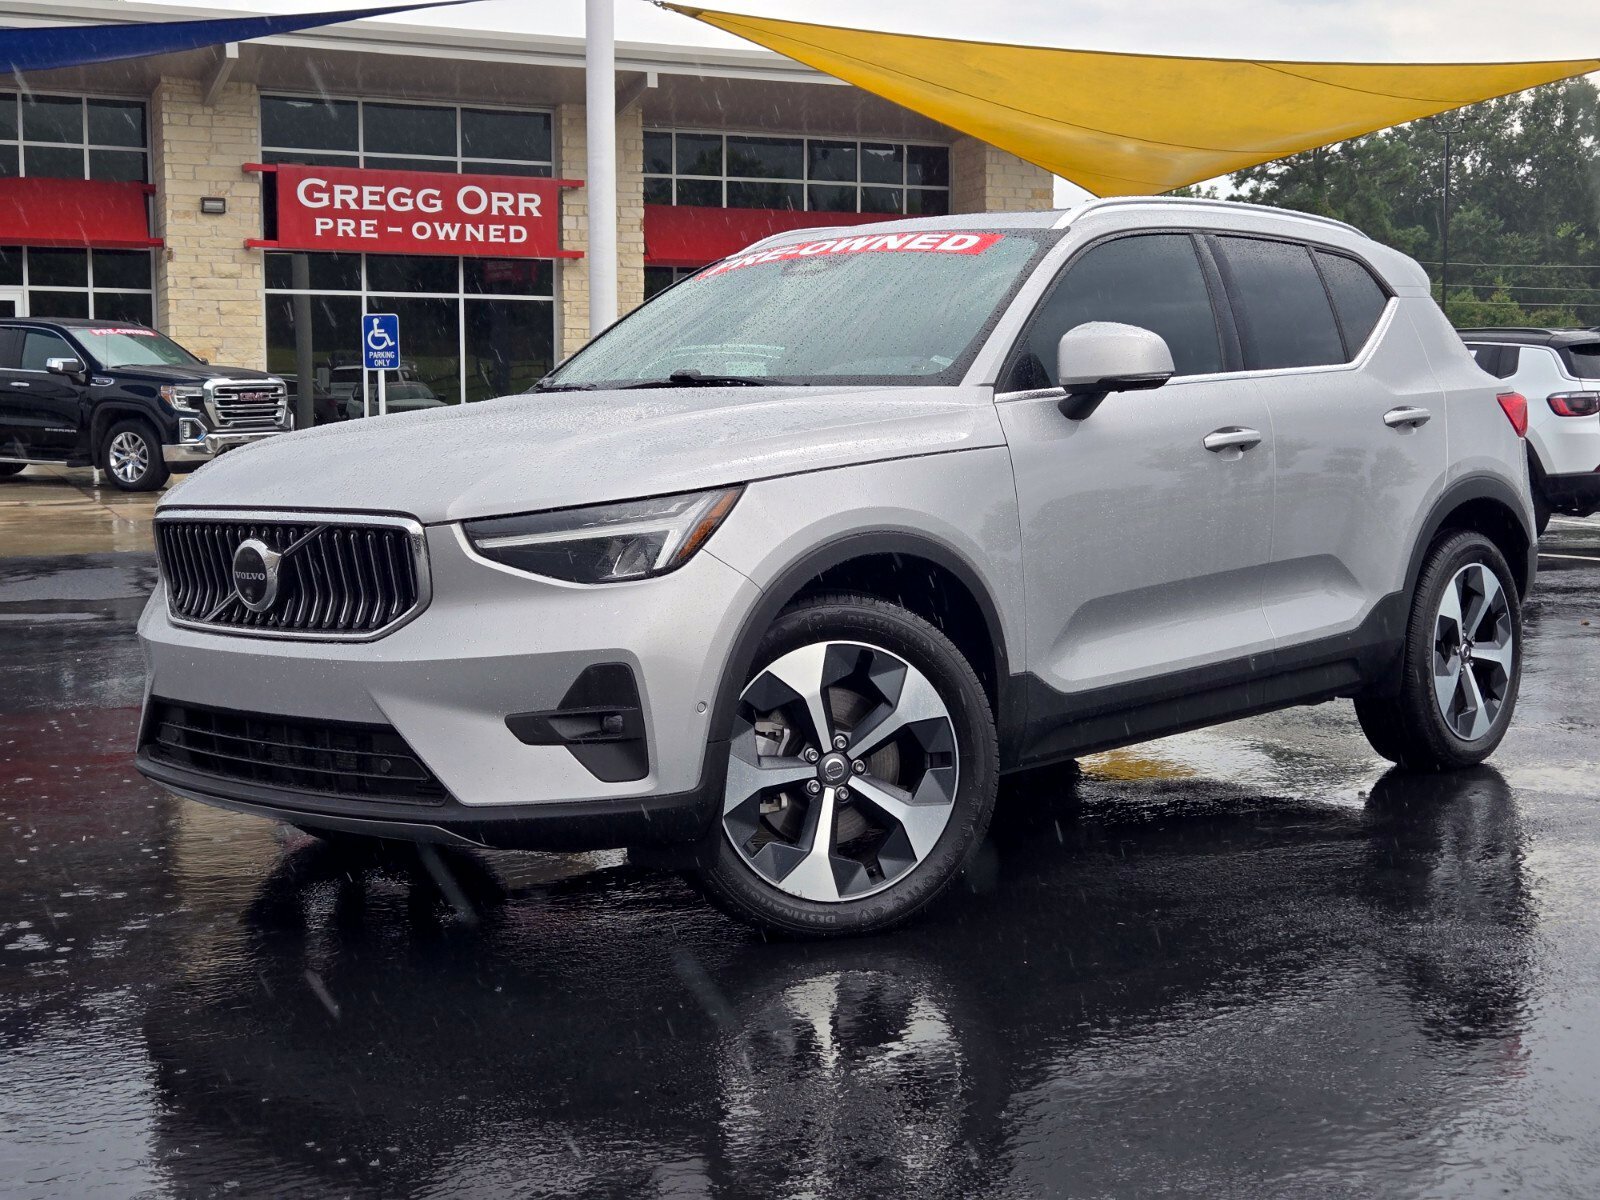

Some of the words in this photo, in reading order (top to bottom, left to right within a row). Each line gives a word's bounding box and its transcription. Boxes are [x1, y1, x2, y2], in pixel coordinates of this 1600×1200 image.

[296, 178, 443, 214] GREGG
[456, 185, 543, 218] ORR
[368, 351, 395, 359] PARKING
[374, 359, 391, 367] ONLY
[240, 392, 269, 402] GMC
[234, 571, 266, 581] VOLVO
